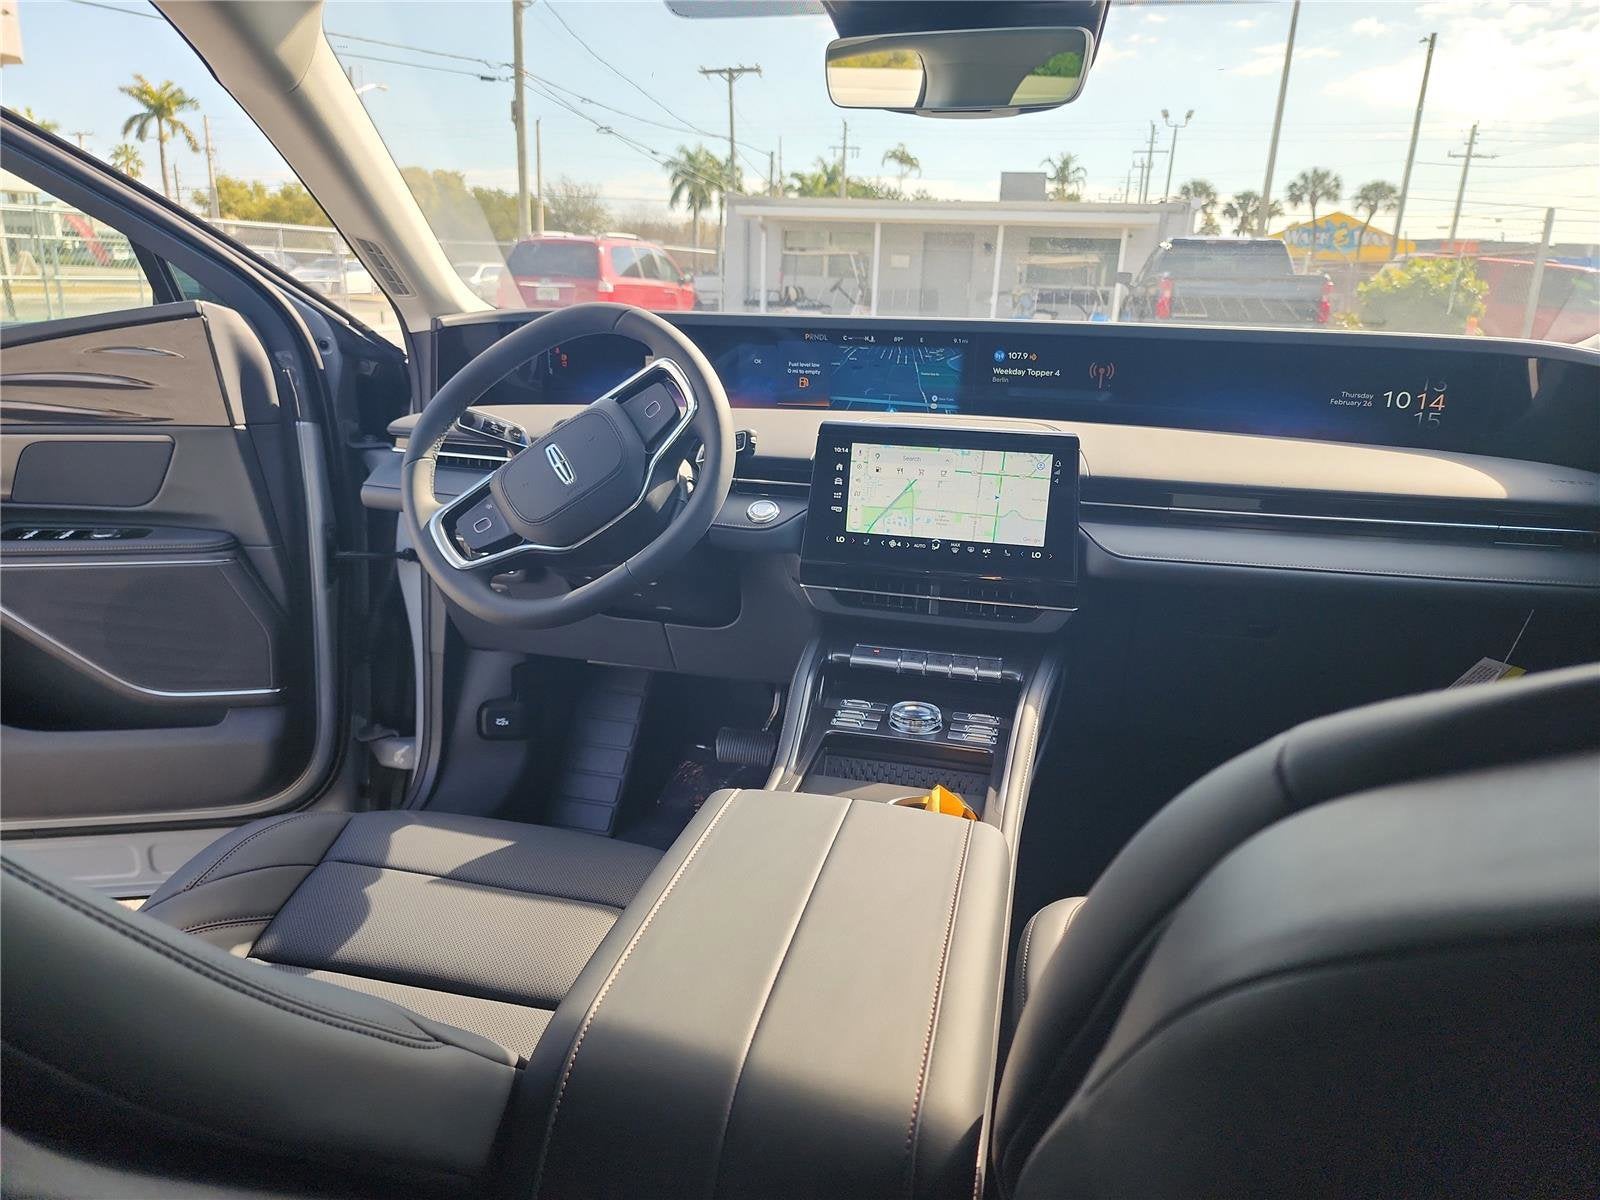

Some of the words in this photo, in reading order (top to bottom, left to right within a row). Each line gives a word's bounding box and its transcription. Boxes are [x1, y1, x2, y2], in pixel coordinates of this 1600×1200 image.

[1008, 352, 1028, 360] 107.9
[992, 367, 1026, 377] Weekday
[1027, 368, 1053, 378] Topper
[1054, 369, 1061, 377] 4
[992, 376, 1009, 384] Berlin
[1341, 391, 1374, 400] Thursday
[1330, 398, 1362, 408] February
[1383, 390, 1412, 409] 10
[1416, 393, 1446, 411] 14
[833, 446, 849, 454] 10:14
[902, 455, 922, 463] Search
